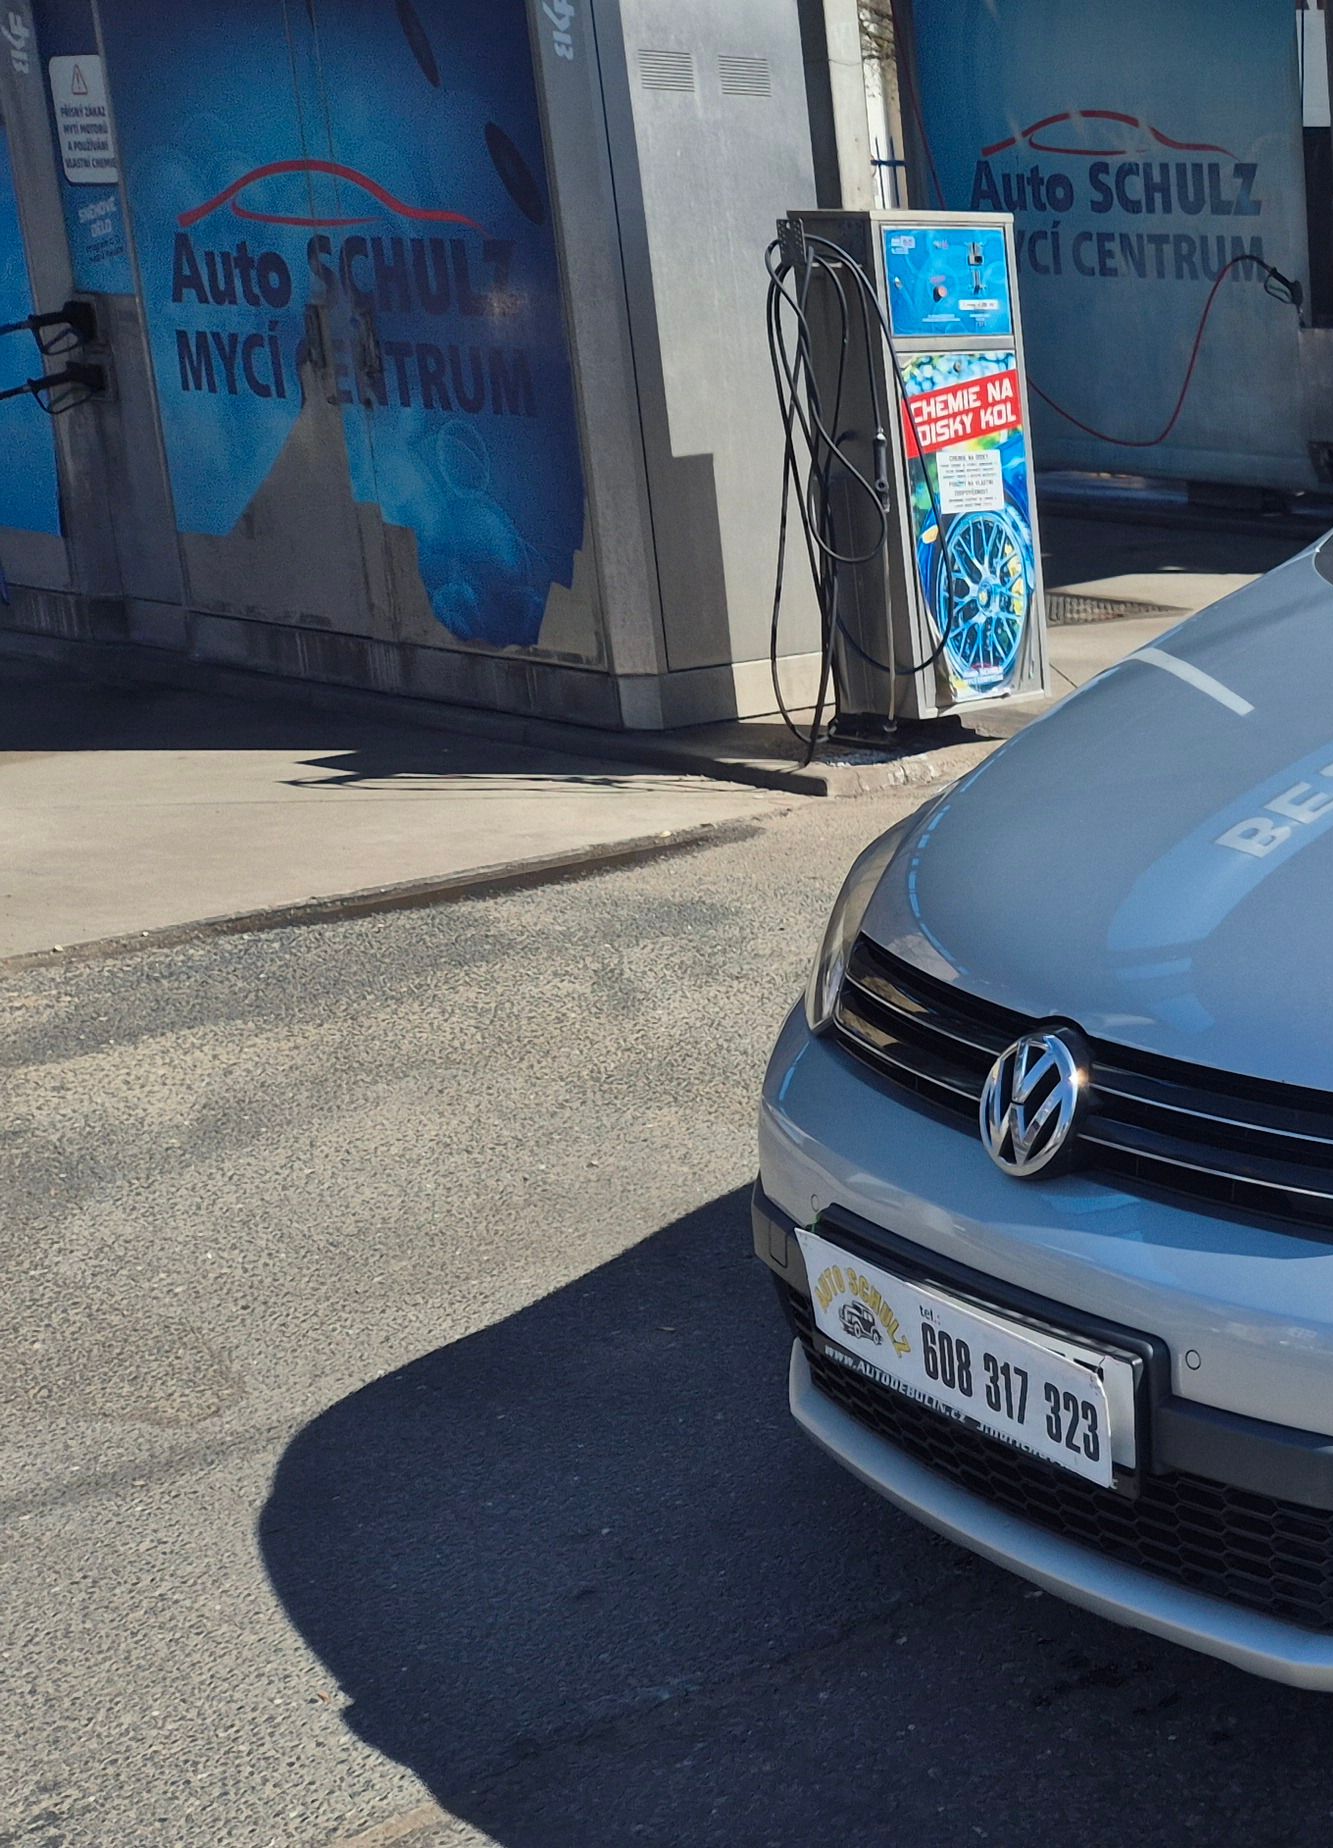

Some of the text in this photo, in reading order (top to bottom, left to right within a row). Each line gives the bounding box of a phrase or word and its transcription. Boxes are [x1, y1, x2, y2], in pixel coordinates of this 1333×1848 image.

[971, 160, 1262, 217] Auto SCHULZ
[172, 232, 292, 308] Auto
[1072, 231, 1267, 283] CENTRUM
[175, 320, 287, 399] MYCÍ
[910, 377, 1014, 424] CHEMIE NA
[917, 401, 1017, 447] DISKY KOL
[815, 1265, 911, 1358] AUTO SCHULZ
[921, 1322, 973, 1398] 608
[983, 1352, 1029, 1425] 317
[1043, 1381, 1101, 1463] 323
